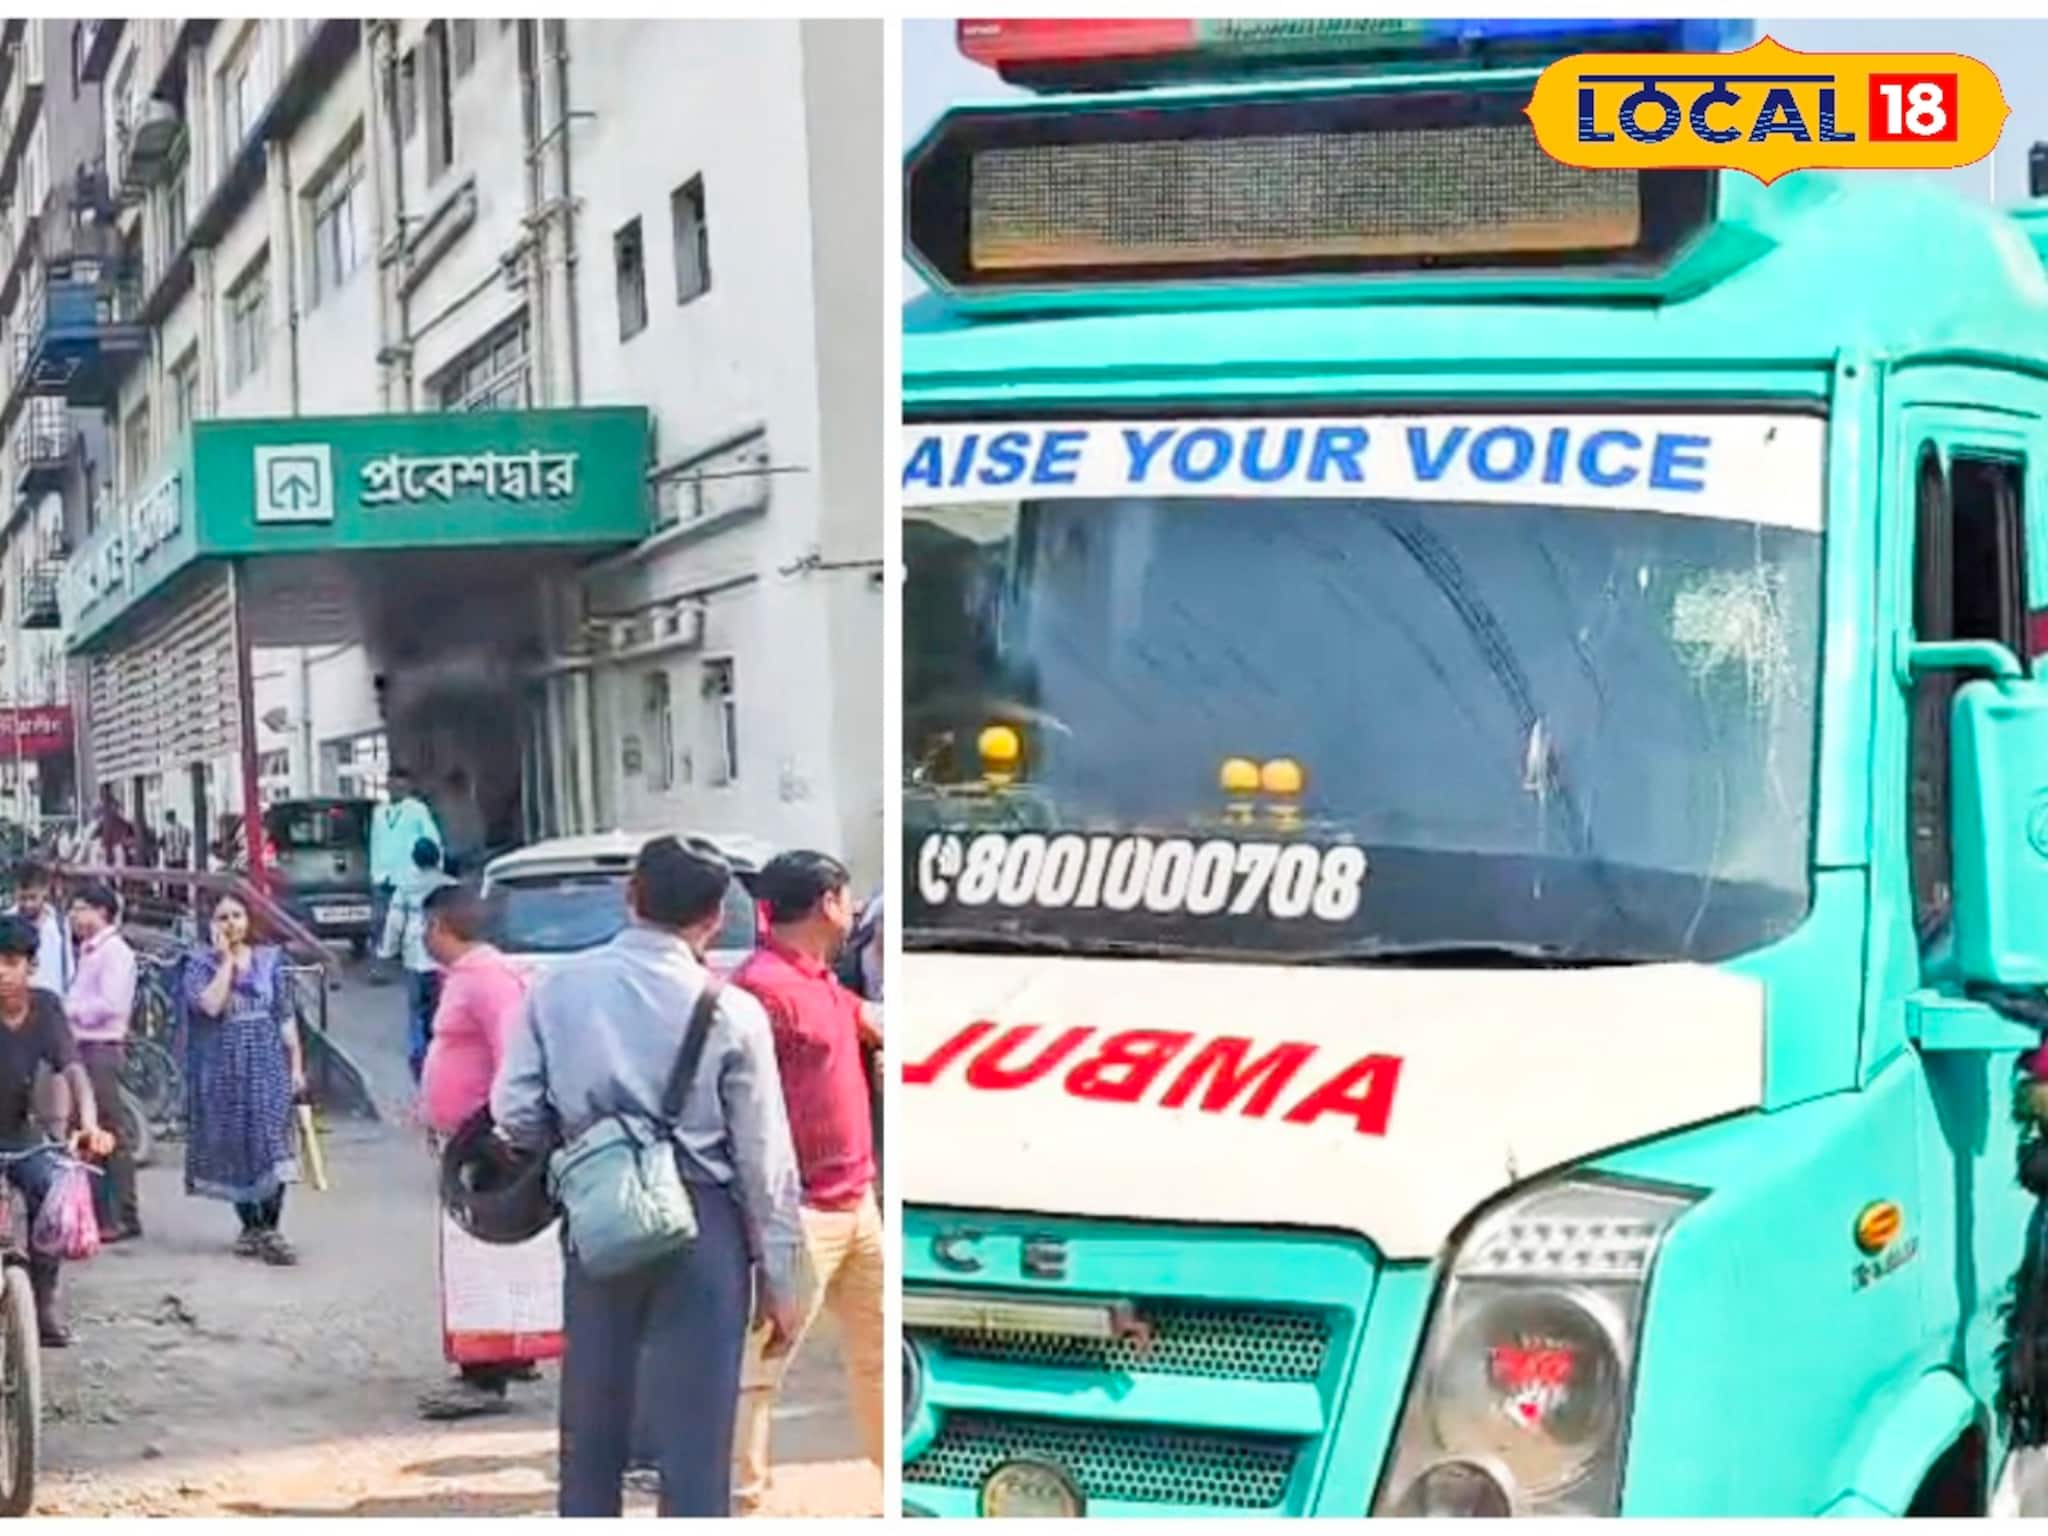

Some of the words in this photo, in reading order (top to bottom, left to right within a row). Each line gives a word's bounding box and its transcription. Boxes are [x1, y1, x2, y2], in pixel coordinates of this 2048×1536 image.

[360, 449, 579, 503] প্রবেশদ্বার
[1124, 426, 1371, 485] YOUR
[1407, 425, 1713, 493] VOICE
[956, 834, 1367, 920] 8001000708
